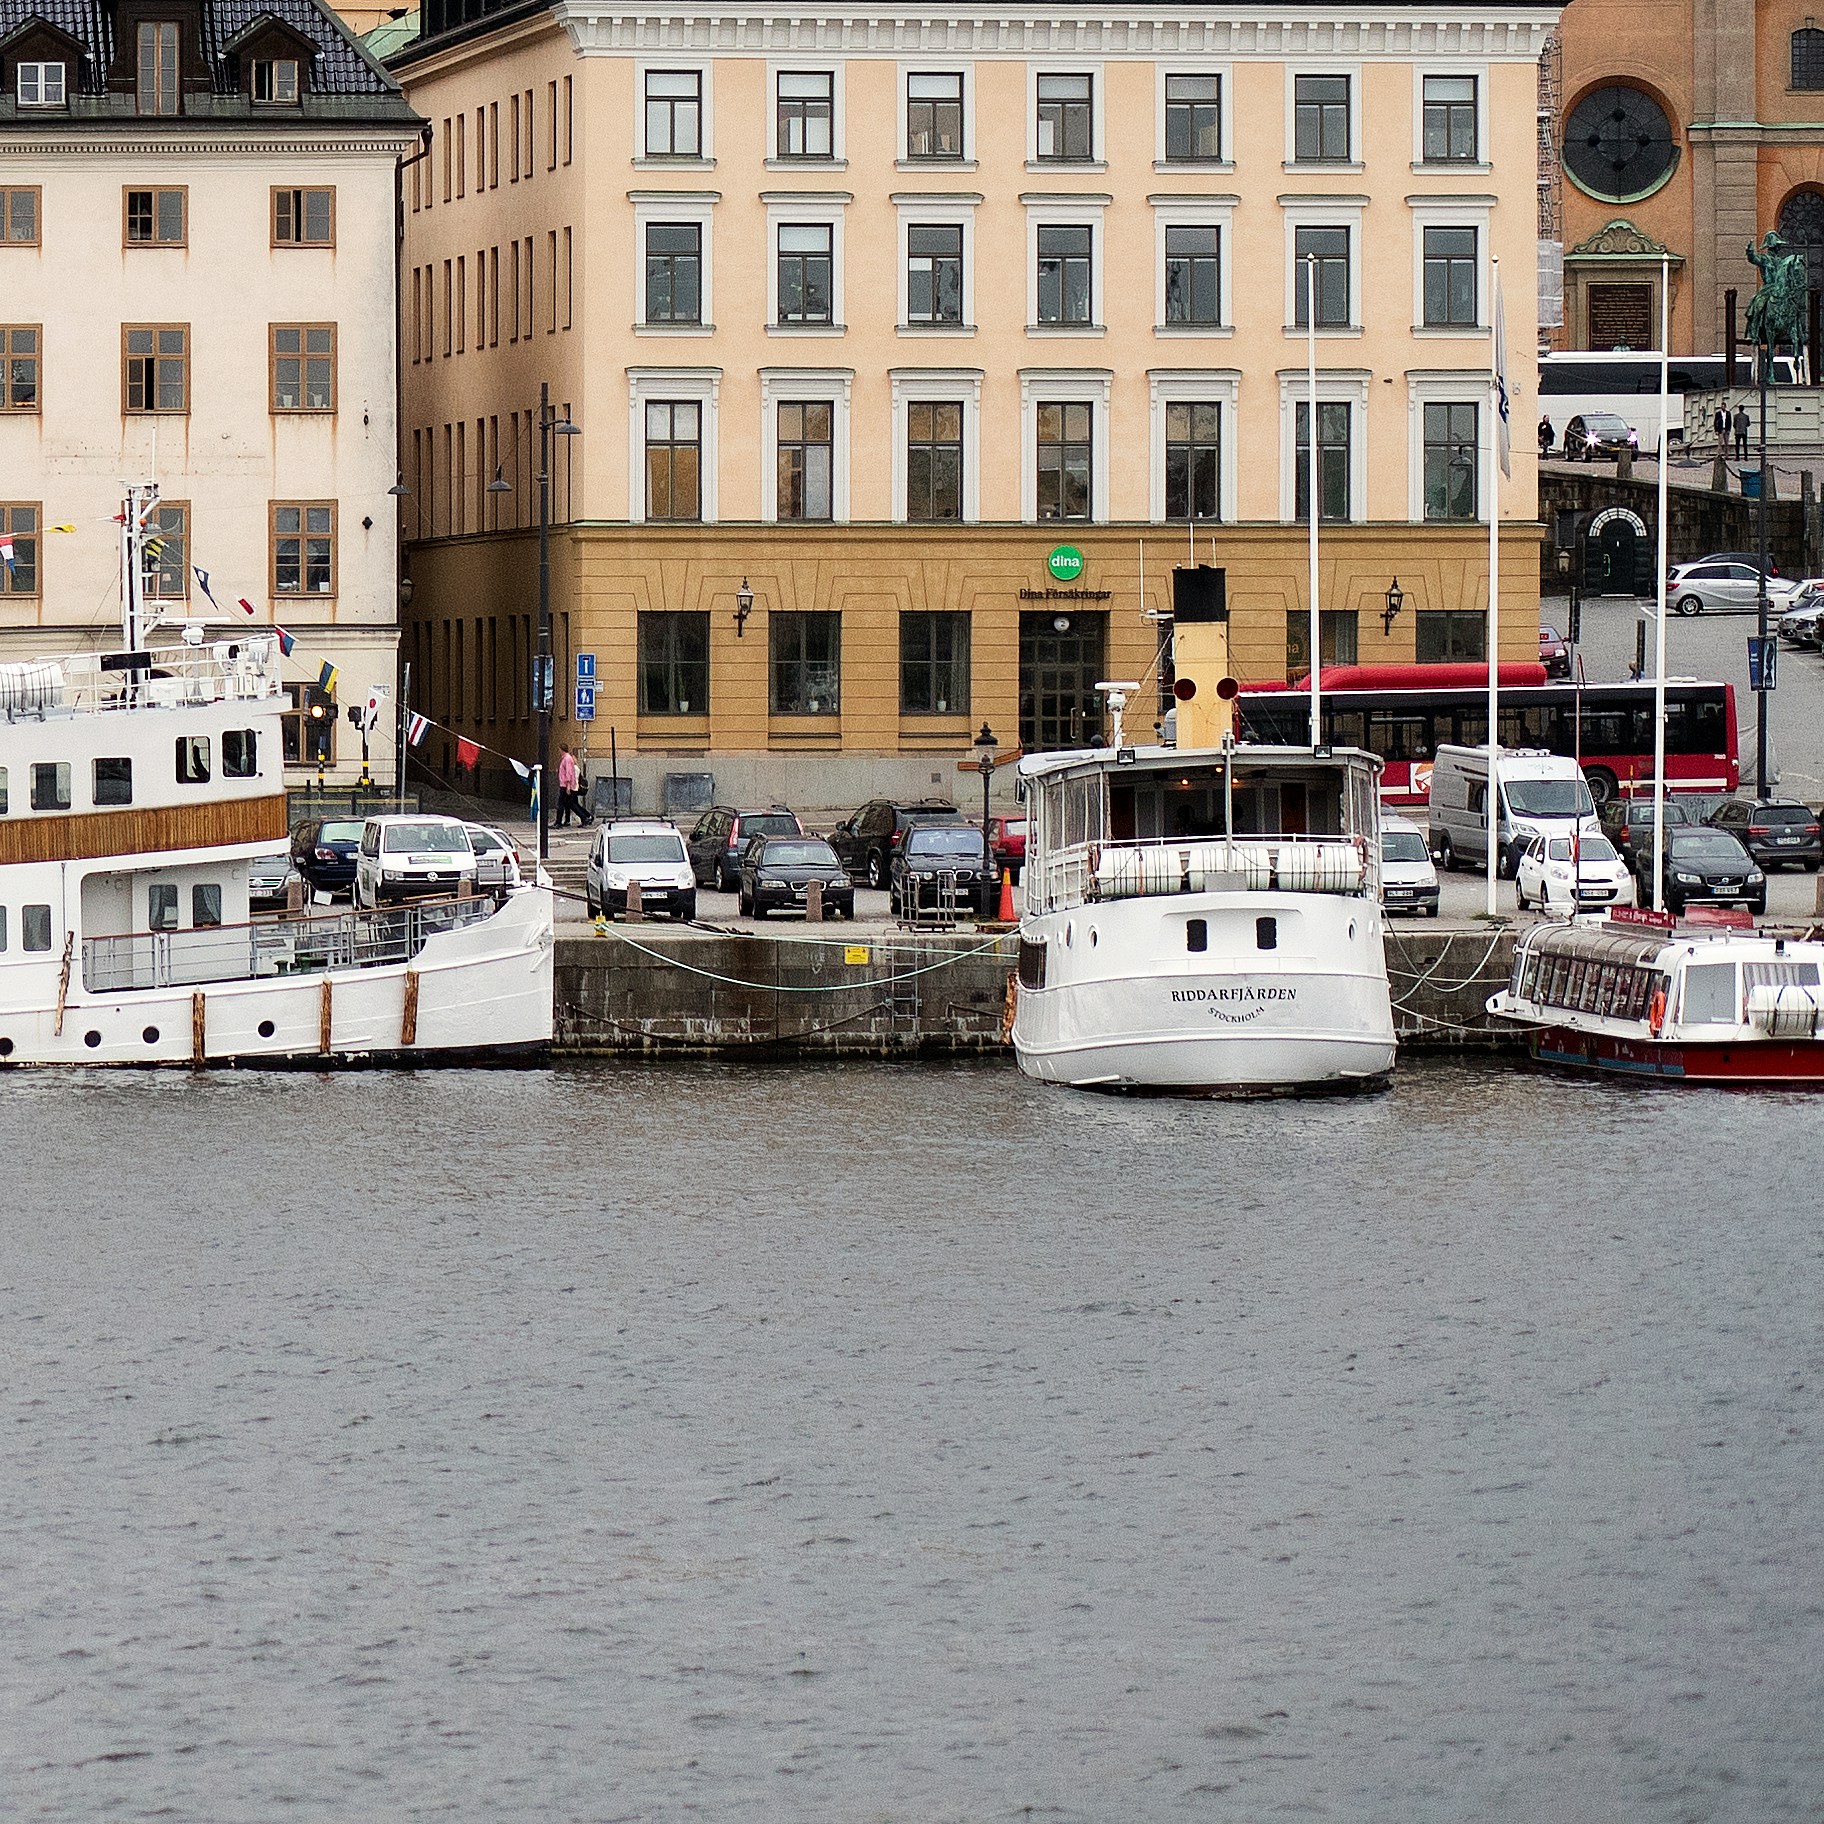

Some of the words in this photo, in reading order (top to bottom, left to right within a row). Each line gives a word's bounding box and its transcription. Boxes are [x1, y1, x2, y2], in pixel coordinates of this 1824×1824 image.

[1051, 555, 1080, 567] dina
[1019, 588, 1044, 600] Dina
[1046, 587, 1112, 602] Försäkringar
[1171, 986, 1297, 1003] RIDDARFJÄRDEN
[1207, 1005, 1265, 1024] STOCKHOLM
